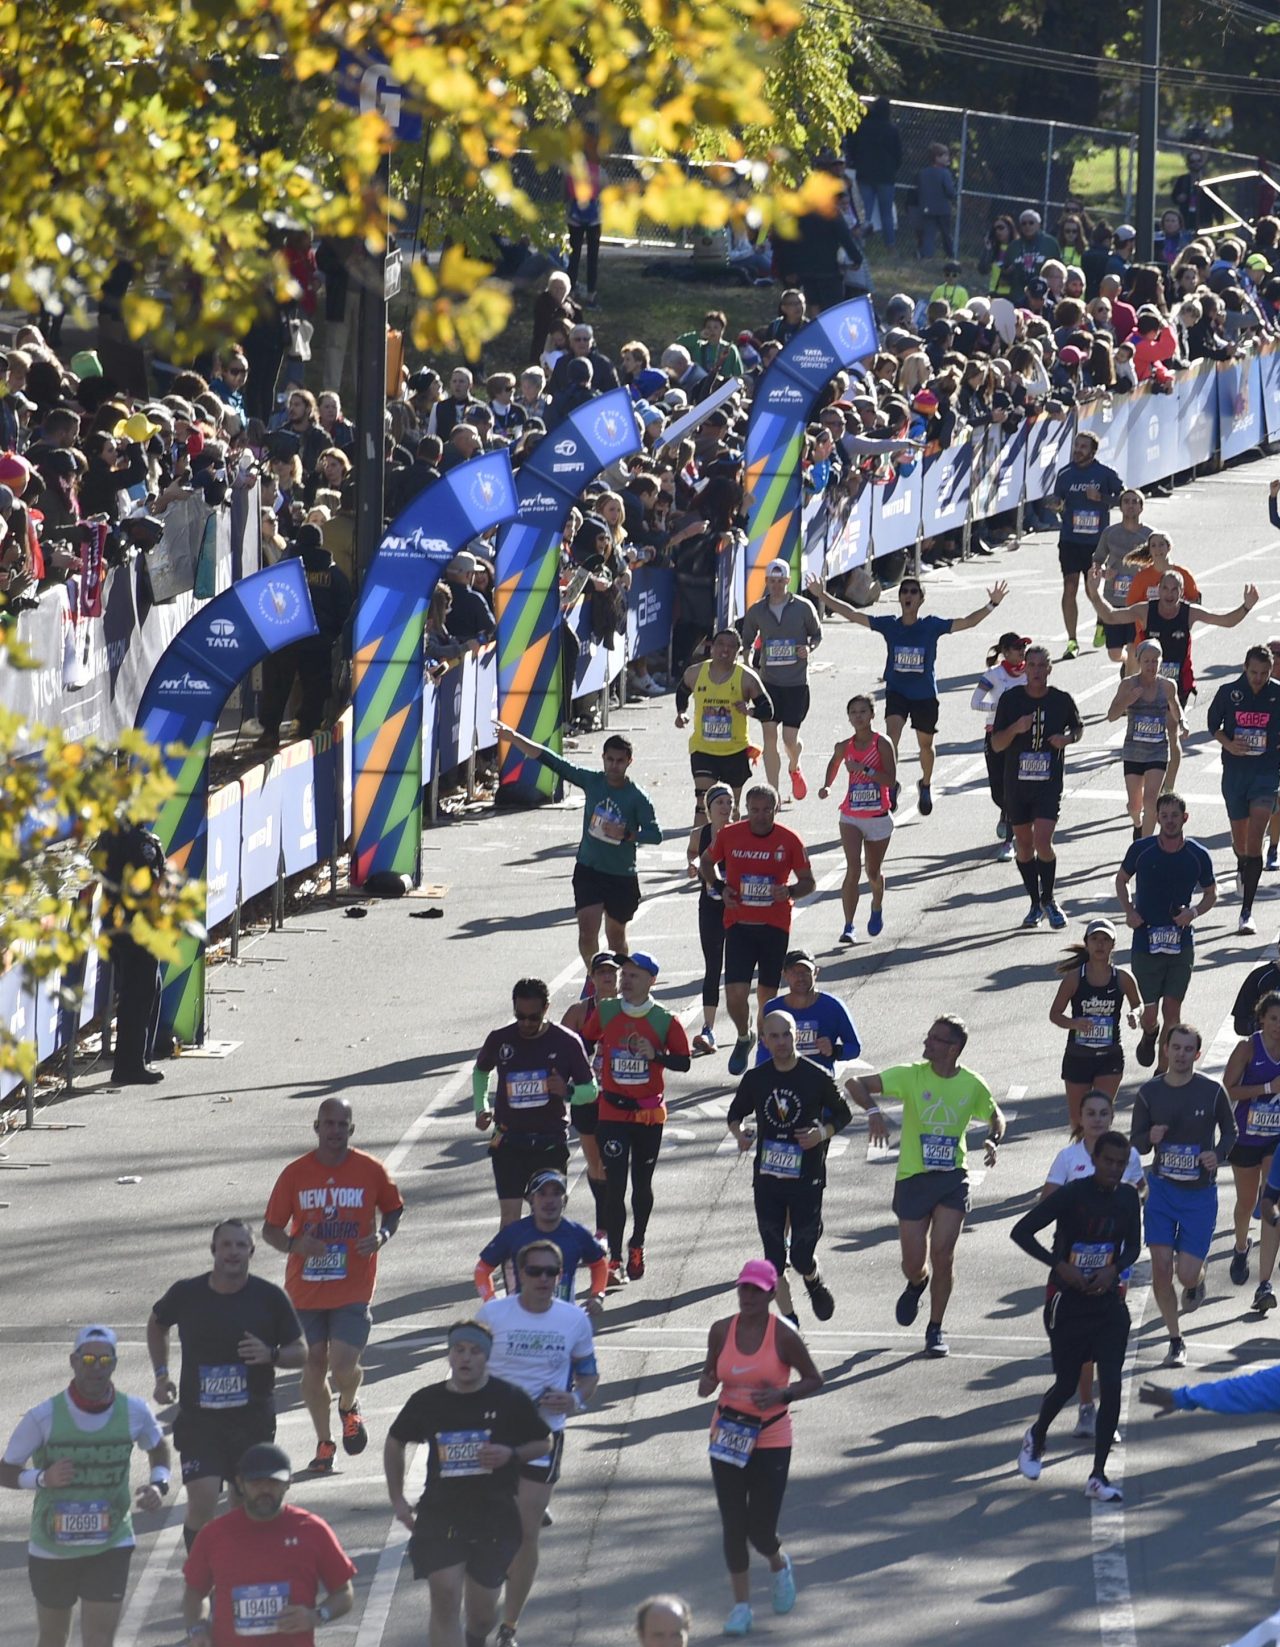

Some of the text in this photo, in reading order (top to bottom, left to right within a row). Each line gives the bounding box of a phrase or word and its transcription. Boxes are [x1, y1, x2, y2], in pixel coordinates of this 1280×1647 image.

[553, 463, 584, 472] ESPN
[380, 530, 452, 552] NYRR
[207, 637, 239, 649] TATA
[159, 675, 210, 689] NYRR
[1236, 712, 1268, 725] GABE
[732, 850, 770, 860] NUNZIO
[1081, 998, 1116, 1010] crown
[617, 1059, 640, 1071] 19441
[514, 1081, 543, 1096] 13272
[767, 1153, 794, 1167] 32172
[926, 1146, 951, 1160] 32515
[1163, 1154, 1195, 1168] 38398
[300, 1188, 364, 1210] NEW YORK
[1077, 1254, 1106, 1267] 13802
[206, 1378, 241, 1393] 22464
[64, 1513, 100, 1532] 12699
[242, 1598, 278, 1616] 19419
